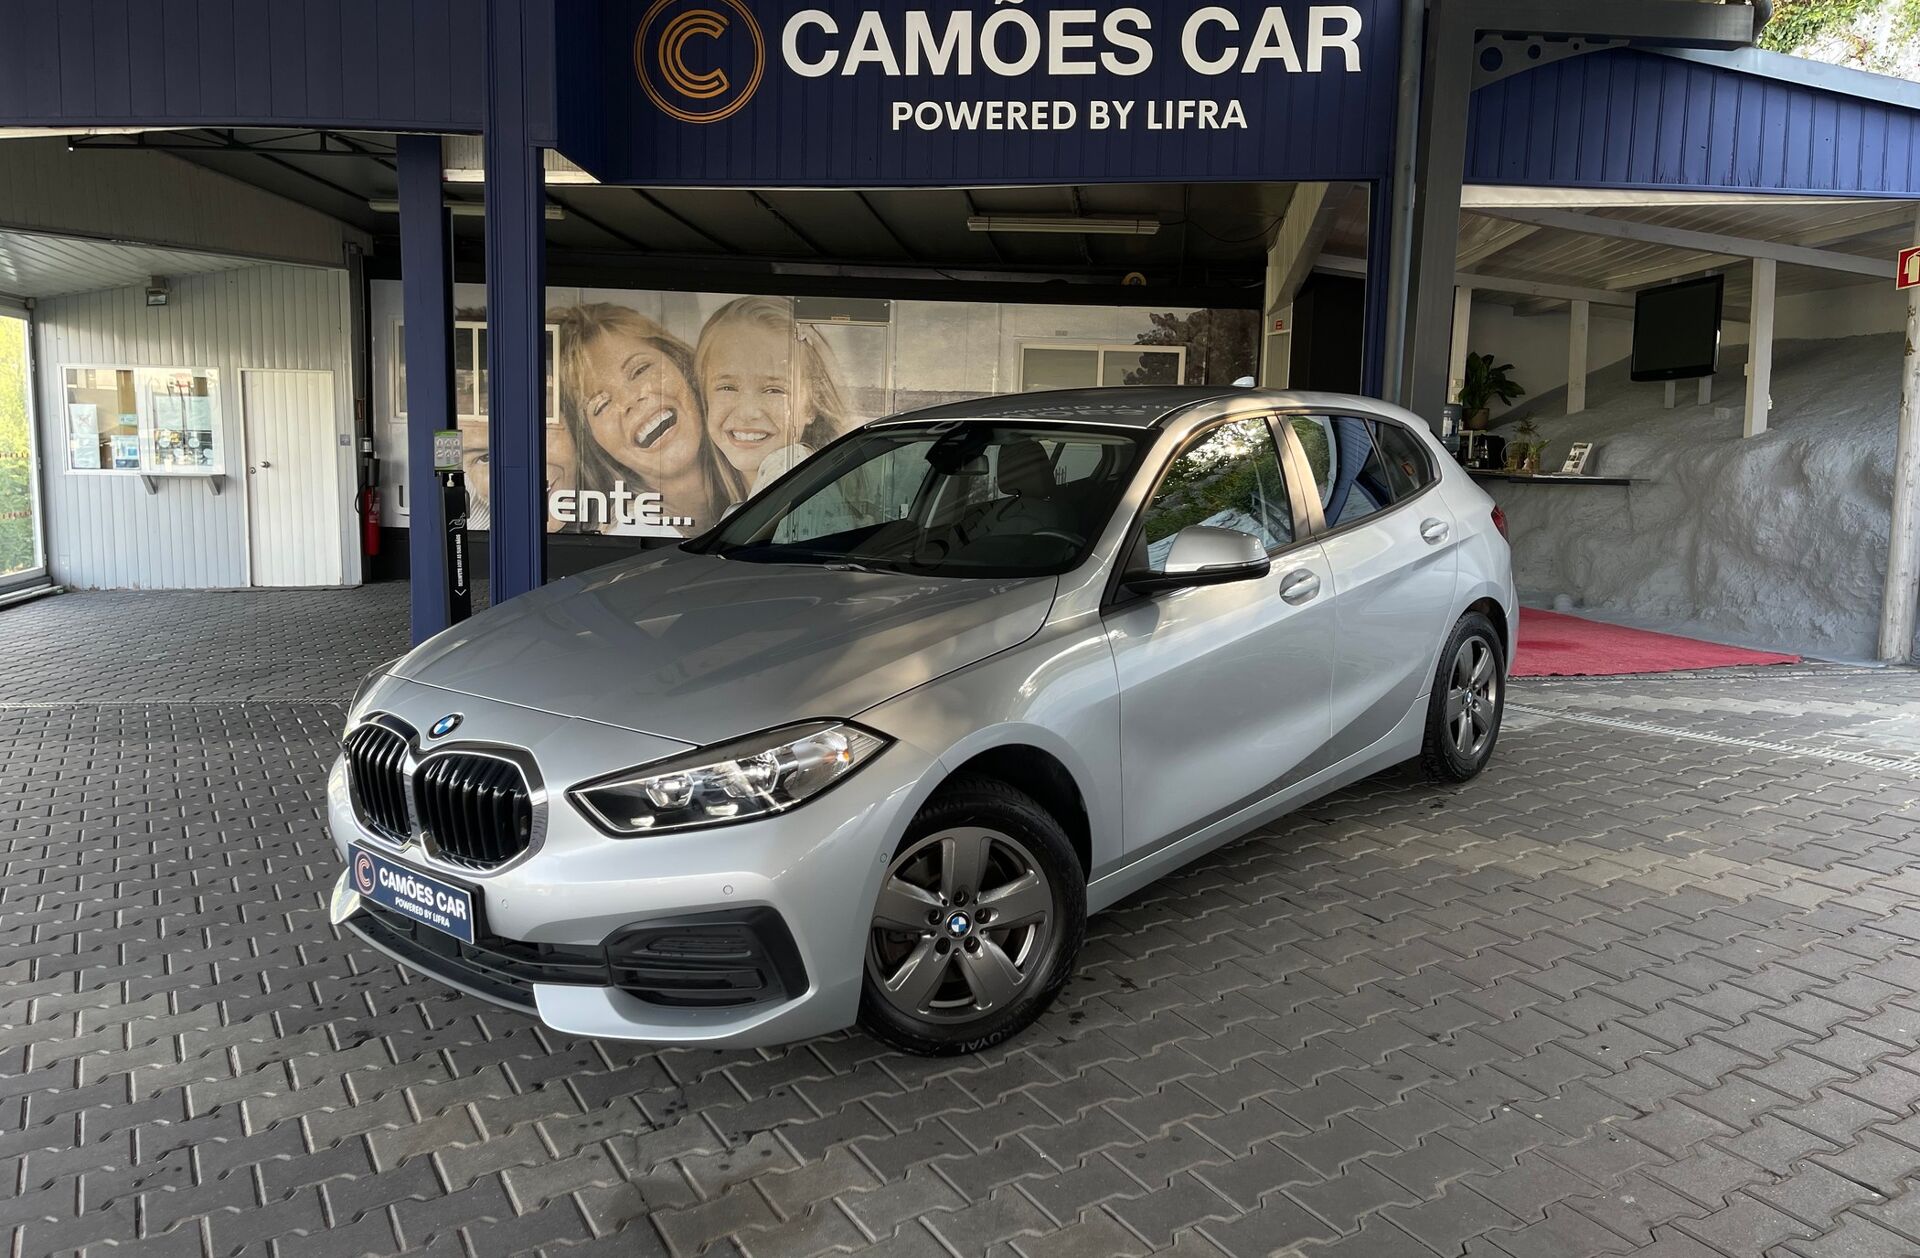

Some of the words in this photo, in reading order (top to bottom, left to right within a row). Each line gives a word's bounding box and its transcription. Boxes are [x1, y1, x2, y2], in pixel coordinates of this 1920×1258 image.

[781, 0, 1154, 77] CAMÕES
[1180, 5, 1363, 75] CAR
[892, 101, 1077, 131] POWERED
[1089, 100, 1136, 131] BY
[1146, 99, 1248, 130] LIFRA
[546, 480, 692, 526] ente...
[379, 868, 434, 907] CAMÕES
[436, 892, 467, 920] CAR
[394, 896, 423, 915] POWERED
[424, 908, 433, 920] BY
